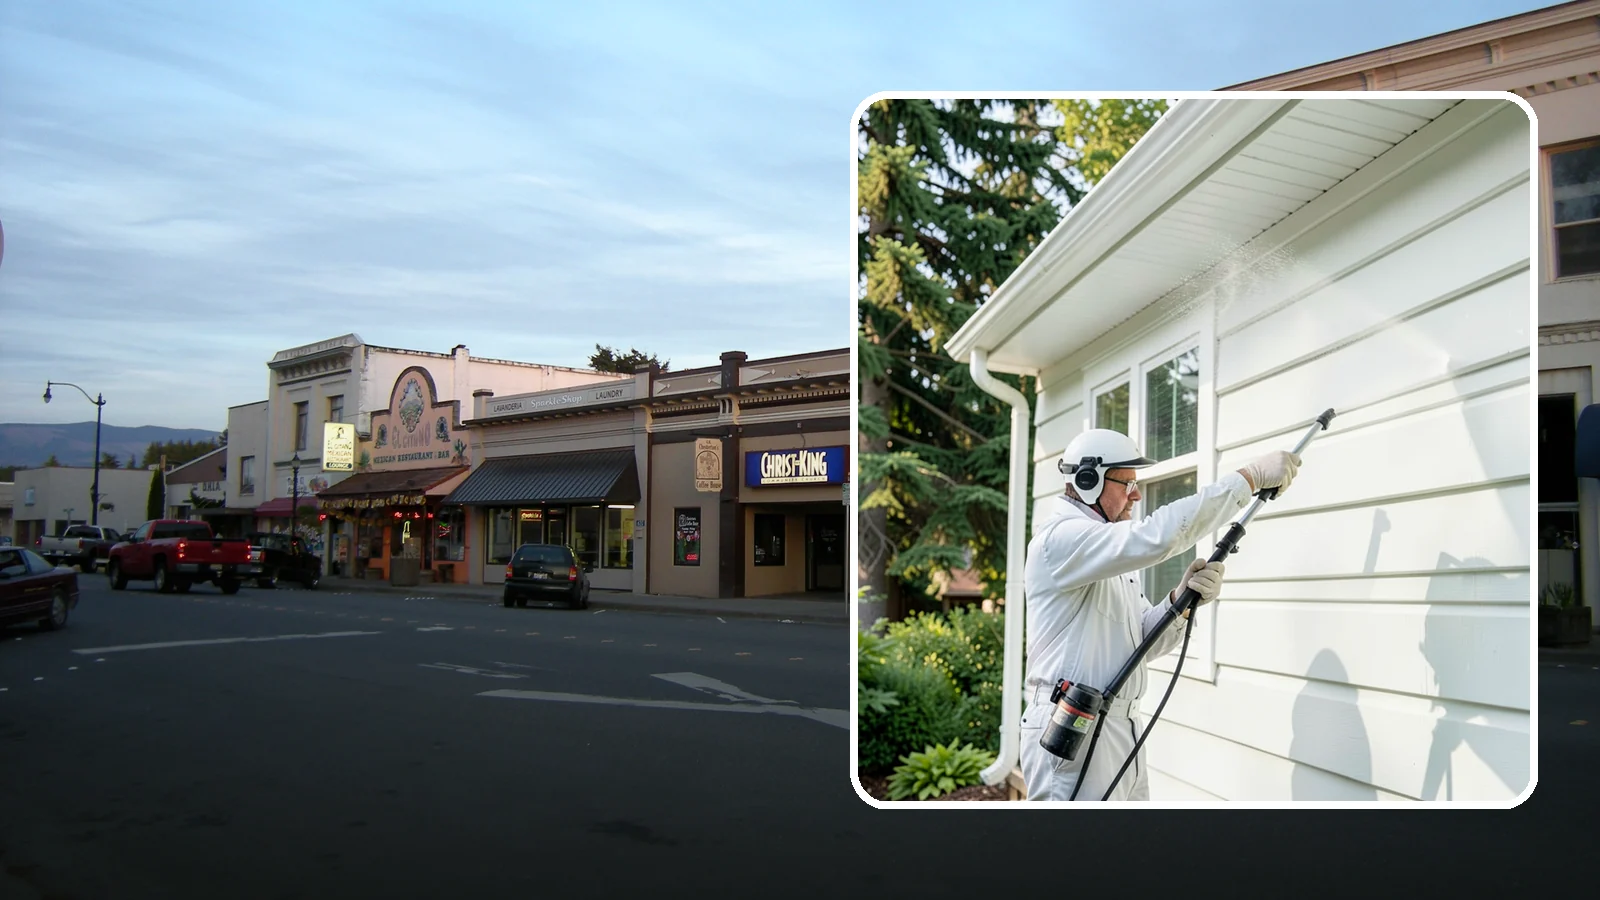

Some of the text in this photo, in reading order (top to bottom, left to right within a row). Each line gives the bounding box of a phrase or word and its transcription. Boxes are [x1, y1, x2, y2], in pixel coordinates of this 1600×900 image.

[493, 389, 624, 413] LAVANDERIA Sparkle Shop LAUNDRY
[373, 455, 396, 464] MEXICAN
[397, 451, 434, 462] RESTAURANT
[437, 450, 450, 459] BAR
